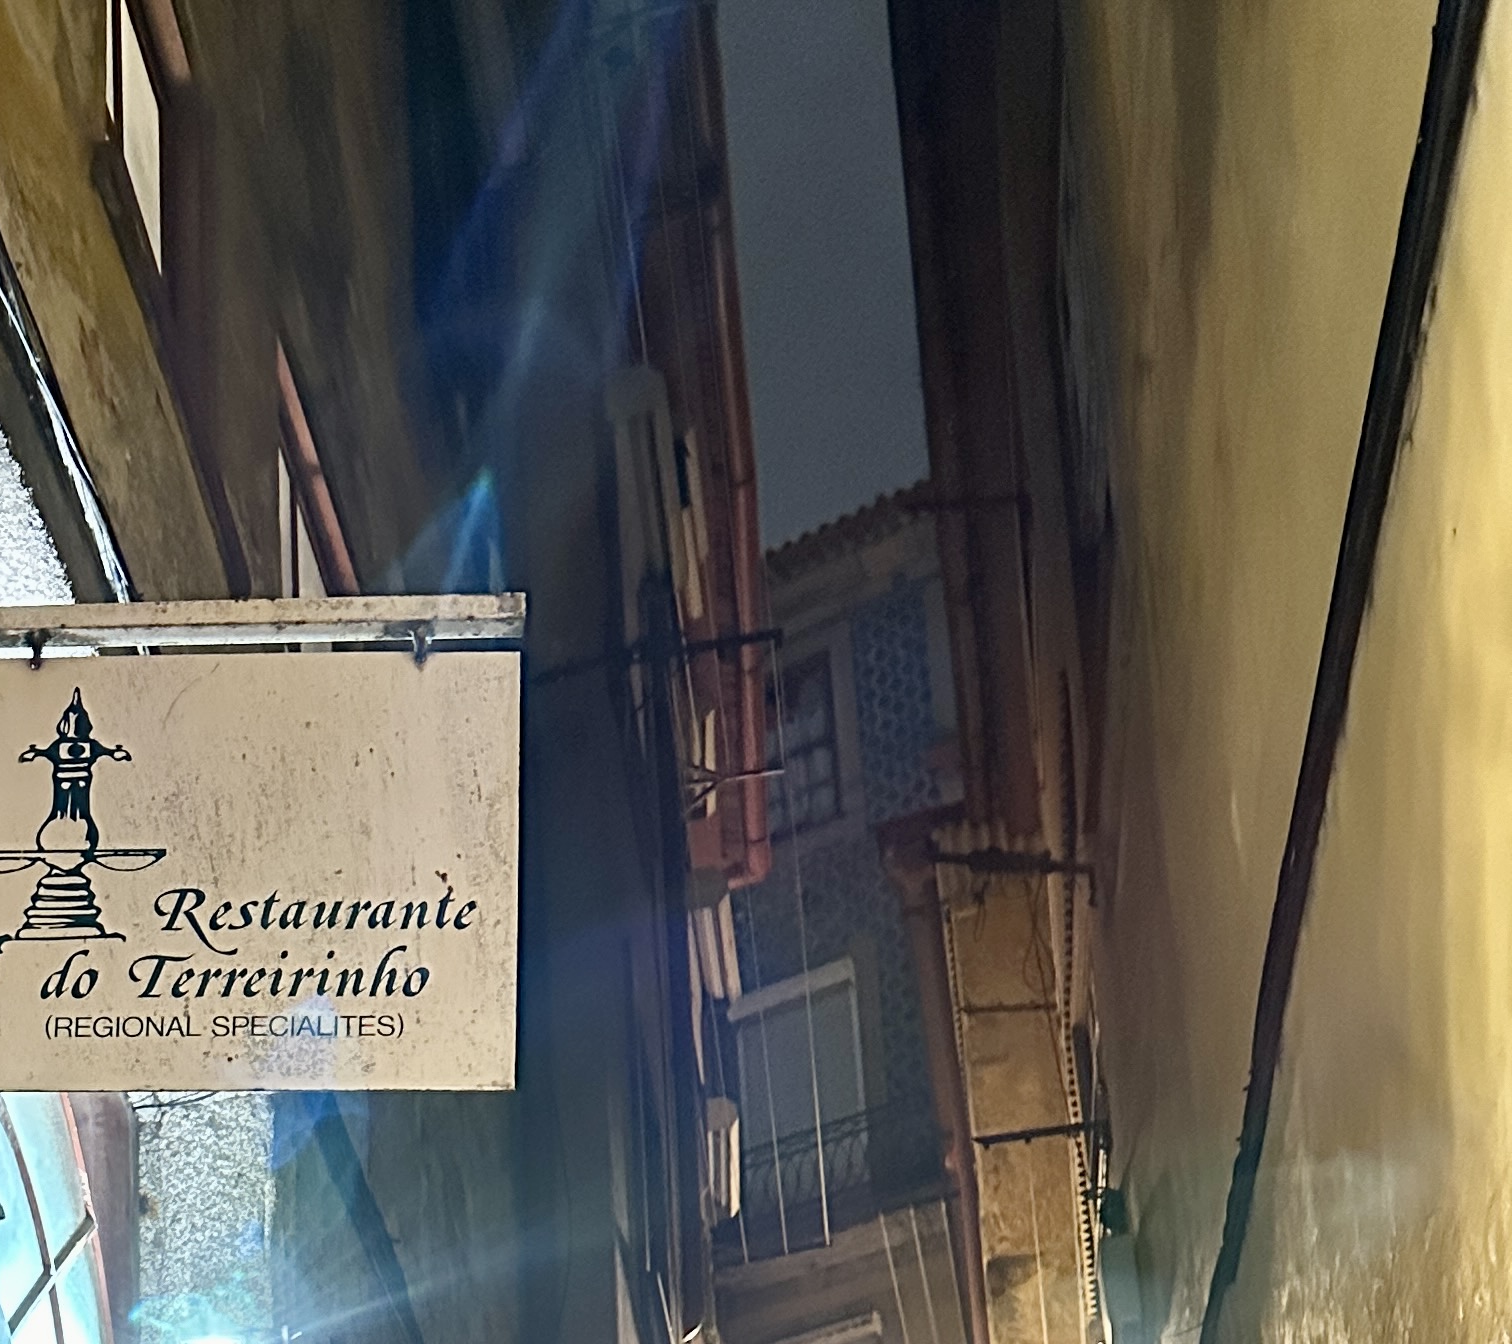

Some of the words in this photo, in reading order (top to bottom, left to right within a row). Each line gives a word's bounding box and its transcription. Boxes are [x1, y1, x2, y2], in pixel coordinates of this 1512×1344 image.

[153, 886, 477, 954] Restaurante
[40, 949, 99, 999] do
[128, 945, 430, 998] Terreirinho
[44, 1013, 201, 1039] (REGIONAL
[211, 1013, 405, 1039] SPECIALITES)
